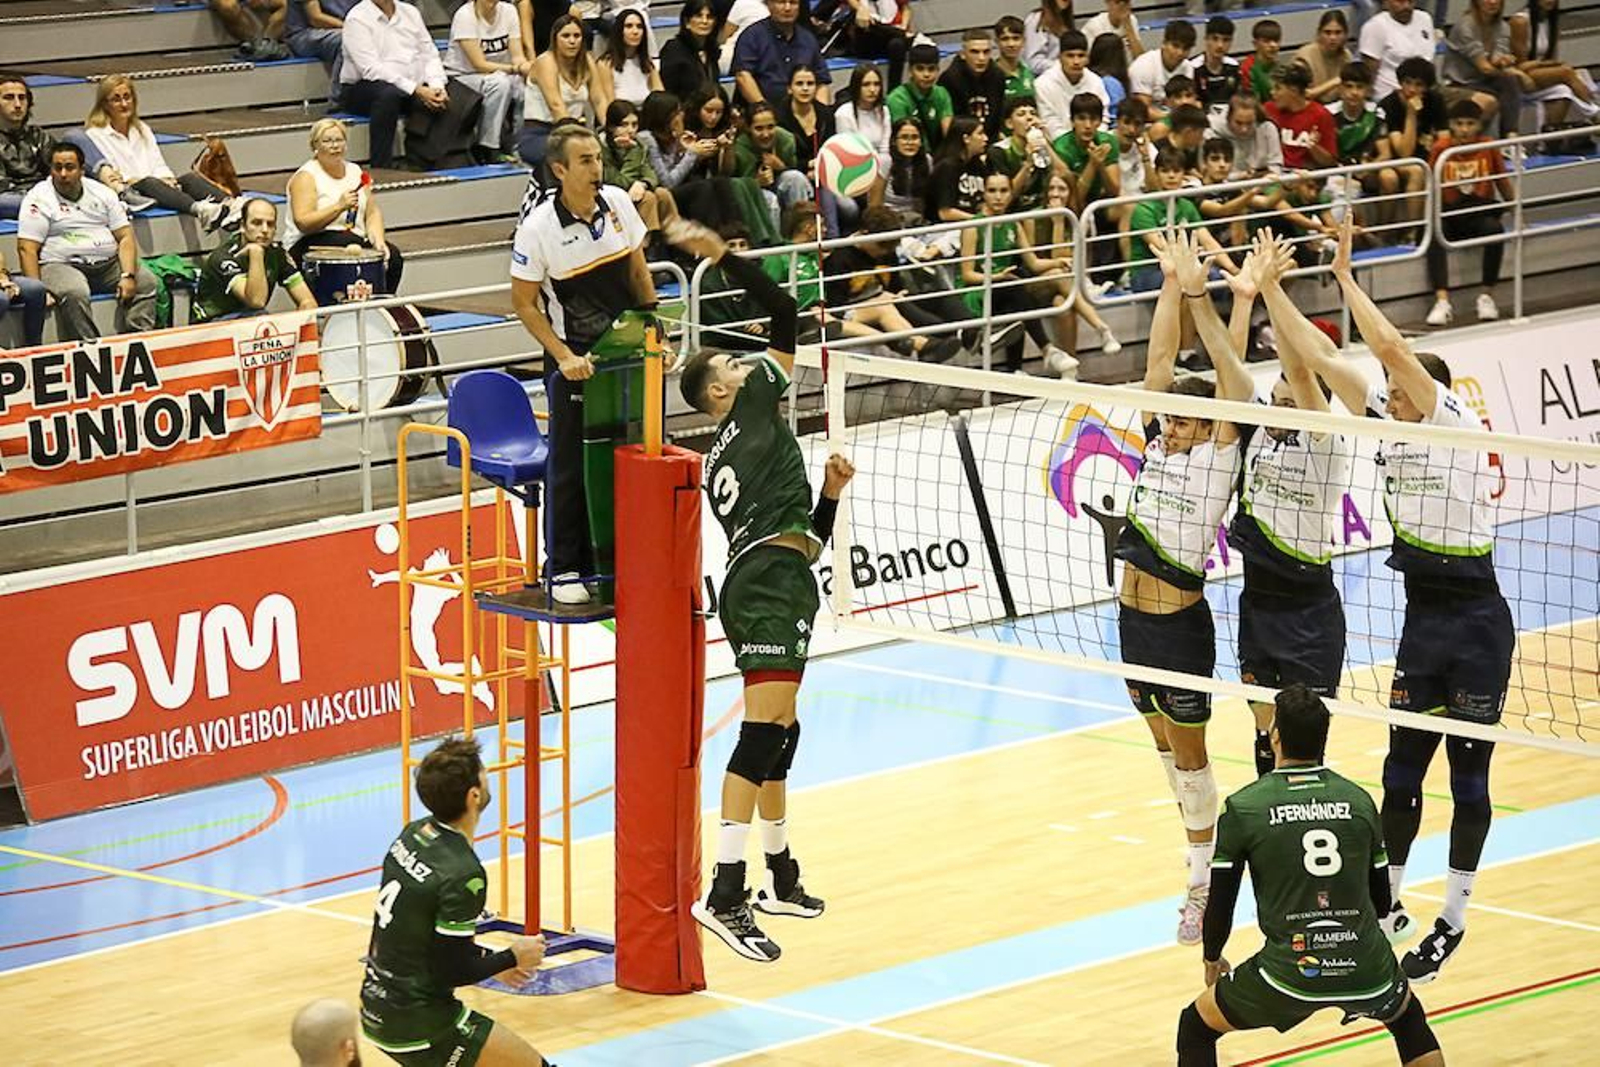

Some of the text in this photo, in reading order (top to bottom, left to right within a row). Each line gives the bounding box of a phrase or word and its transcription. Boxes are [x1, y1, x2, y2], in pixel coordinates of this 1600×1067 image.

[244, 356, 257, 366] LA
[28, 388, 226, 467] UNION
[713, 465, 740, 517] 3
[850, 538, 970, 589] Banco
[67, 593, 301, 727] SVM
[81, 725, 199, 780] SUPERLIGA
[200, 703, 299, 750] VOLEIBOL
[1269, 797, 1352, 825] J.FERNÁNDEZ
[1302, 829, 1343, 877] 8
[375, 879, 402, 930] 4
